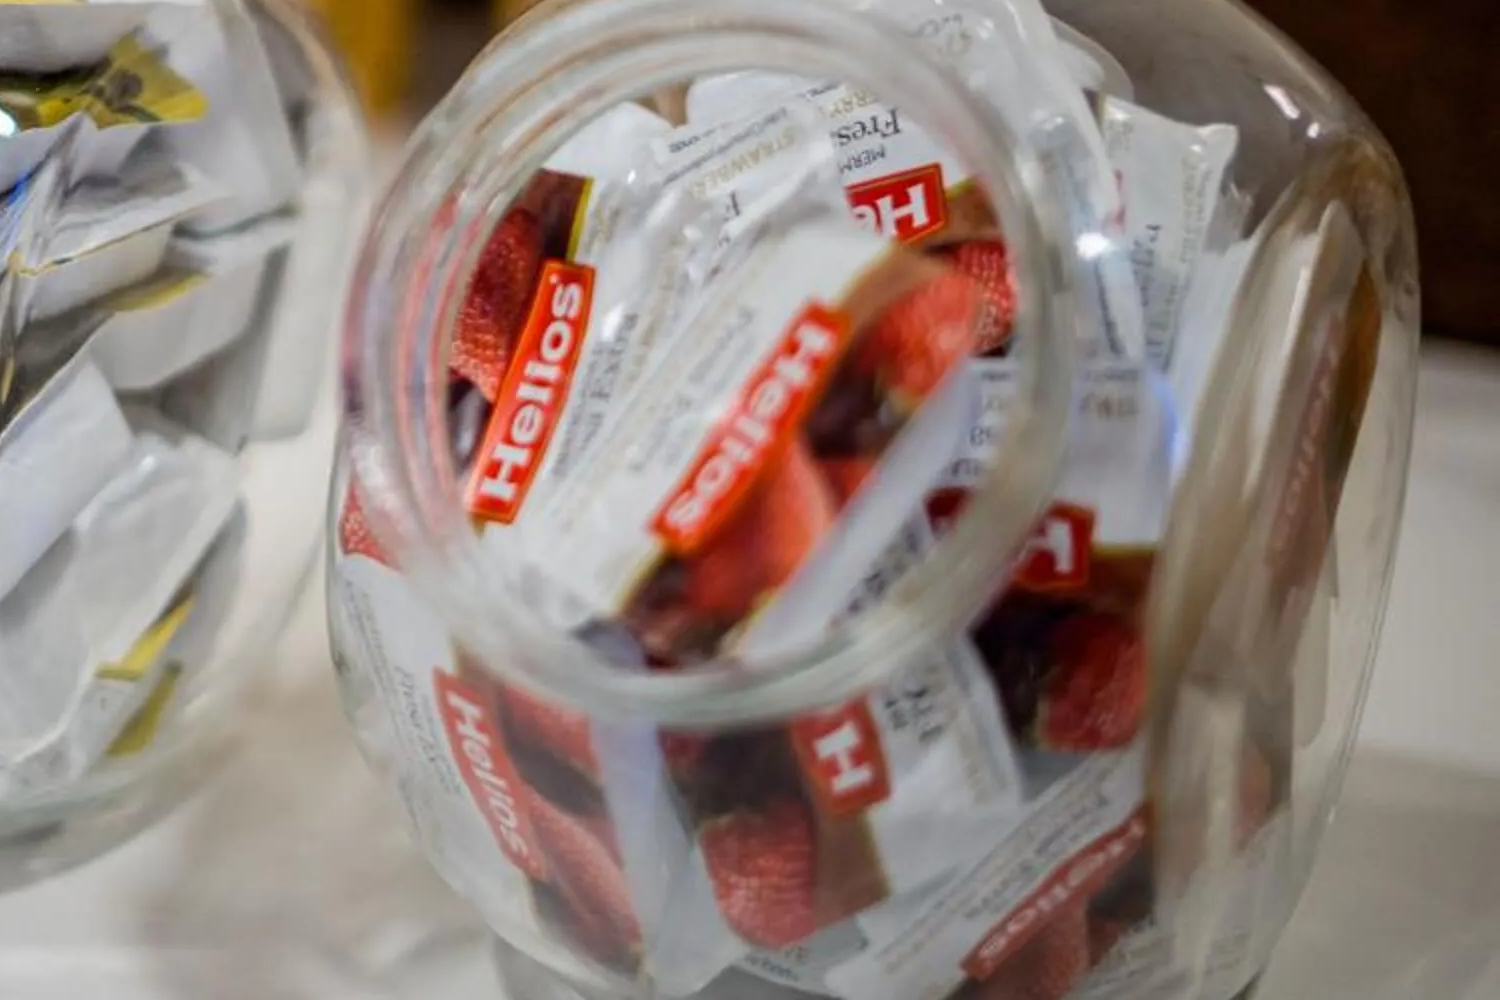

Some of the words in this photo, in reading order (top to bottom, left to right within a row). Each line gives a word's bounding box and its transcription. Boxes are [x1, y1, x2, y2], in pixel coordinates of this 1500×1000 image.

[834, 107, 902, 147] Fres
[836, 145, 885, 174] MERM
[480, 279, 586, 499] Helios
[665, 320, 837, 530] Helios
[444, 691, 529, 854] Helios
